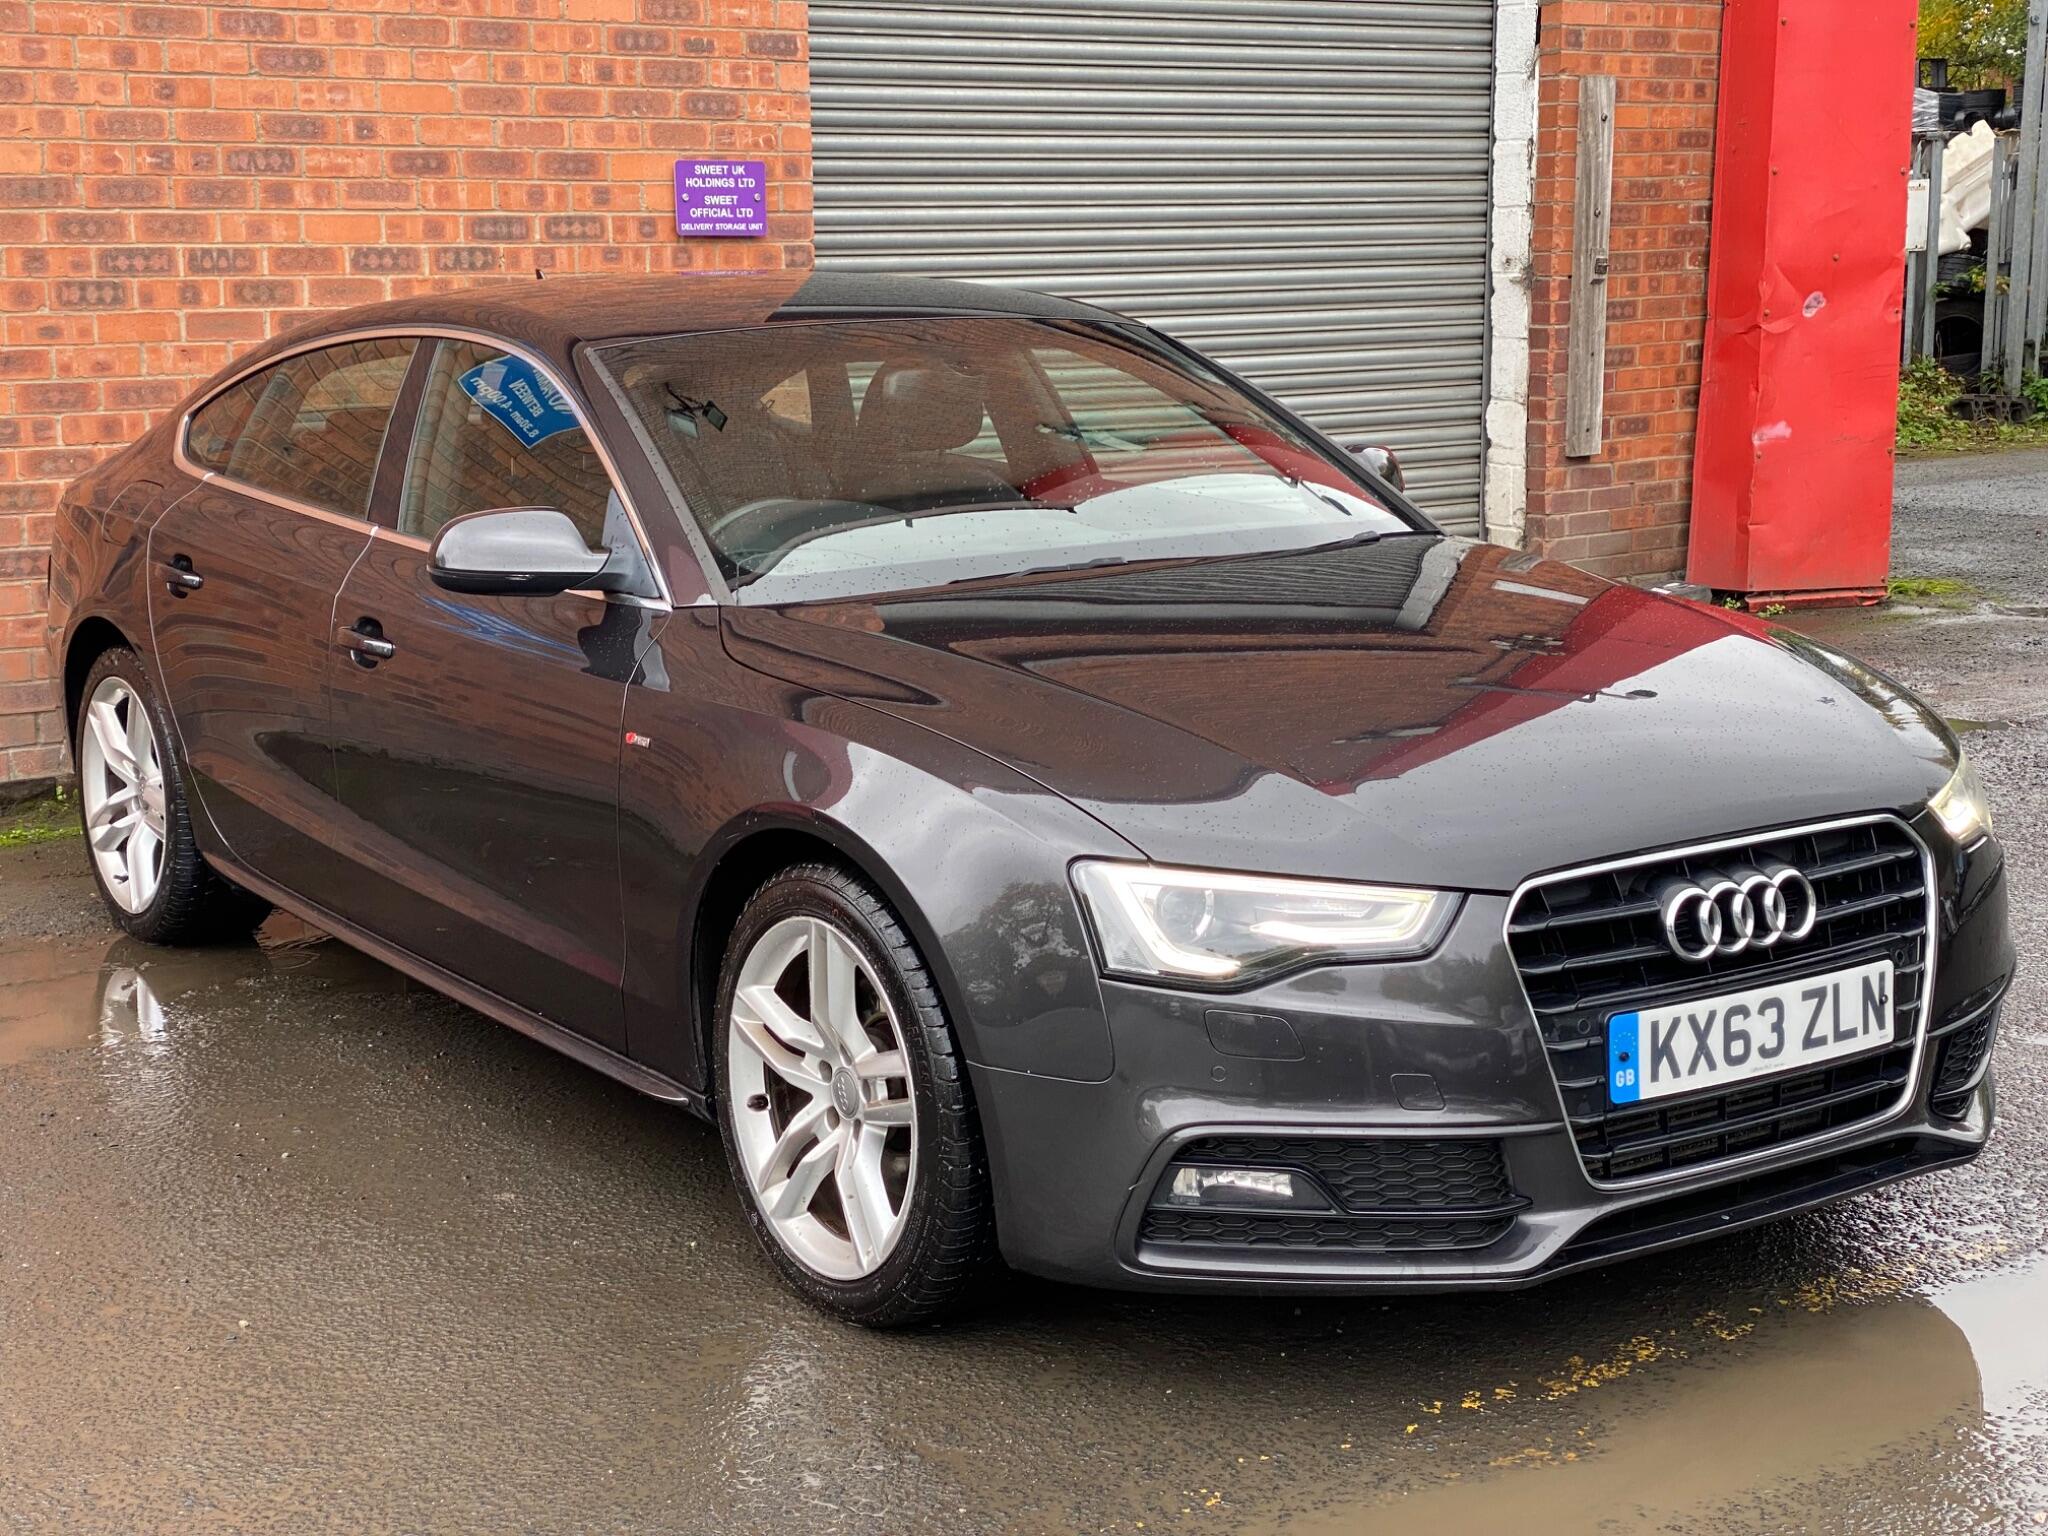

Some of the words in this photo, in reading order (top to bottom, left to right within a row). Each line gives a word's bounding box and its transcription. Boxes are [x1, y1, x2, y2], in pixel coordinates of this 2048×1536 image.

[694, 164, 729, 175] SWEET
[731, 165, 746, 175] UK
[685, 177, 735, 188] HOLDINGS
[738, 178, 756, 188] LTD
[703, 195, 738, 205] SWEET
[689, 207, 734, 218] OFFICIAL
[736, 208, 754, 218] LTD
[681, 222, 714, 231] DELIVERY
[715, 222, 747, 231] STORAGE
[748, 222, 763, 231] UNIT
[1649, 996, 1786, 1084] KX63
[1801, 971, 1886, 1050] ZLN
[1615, 1068, 1636, 1088] GB
